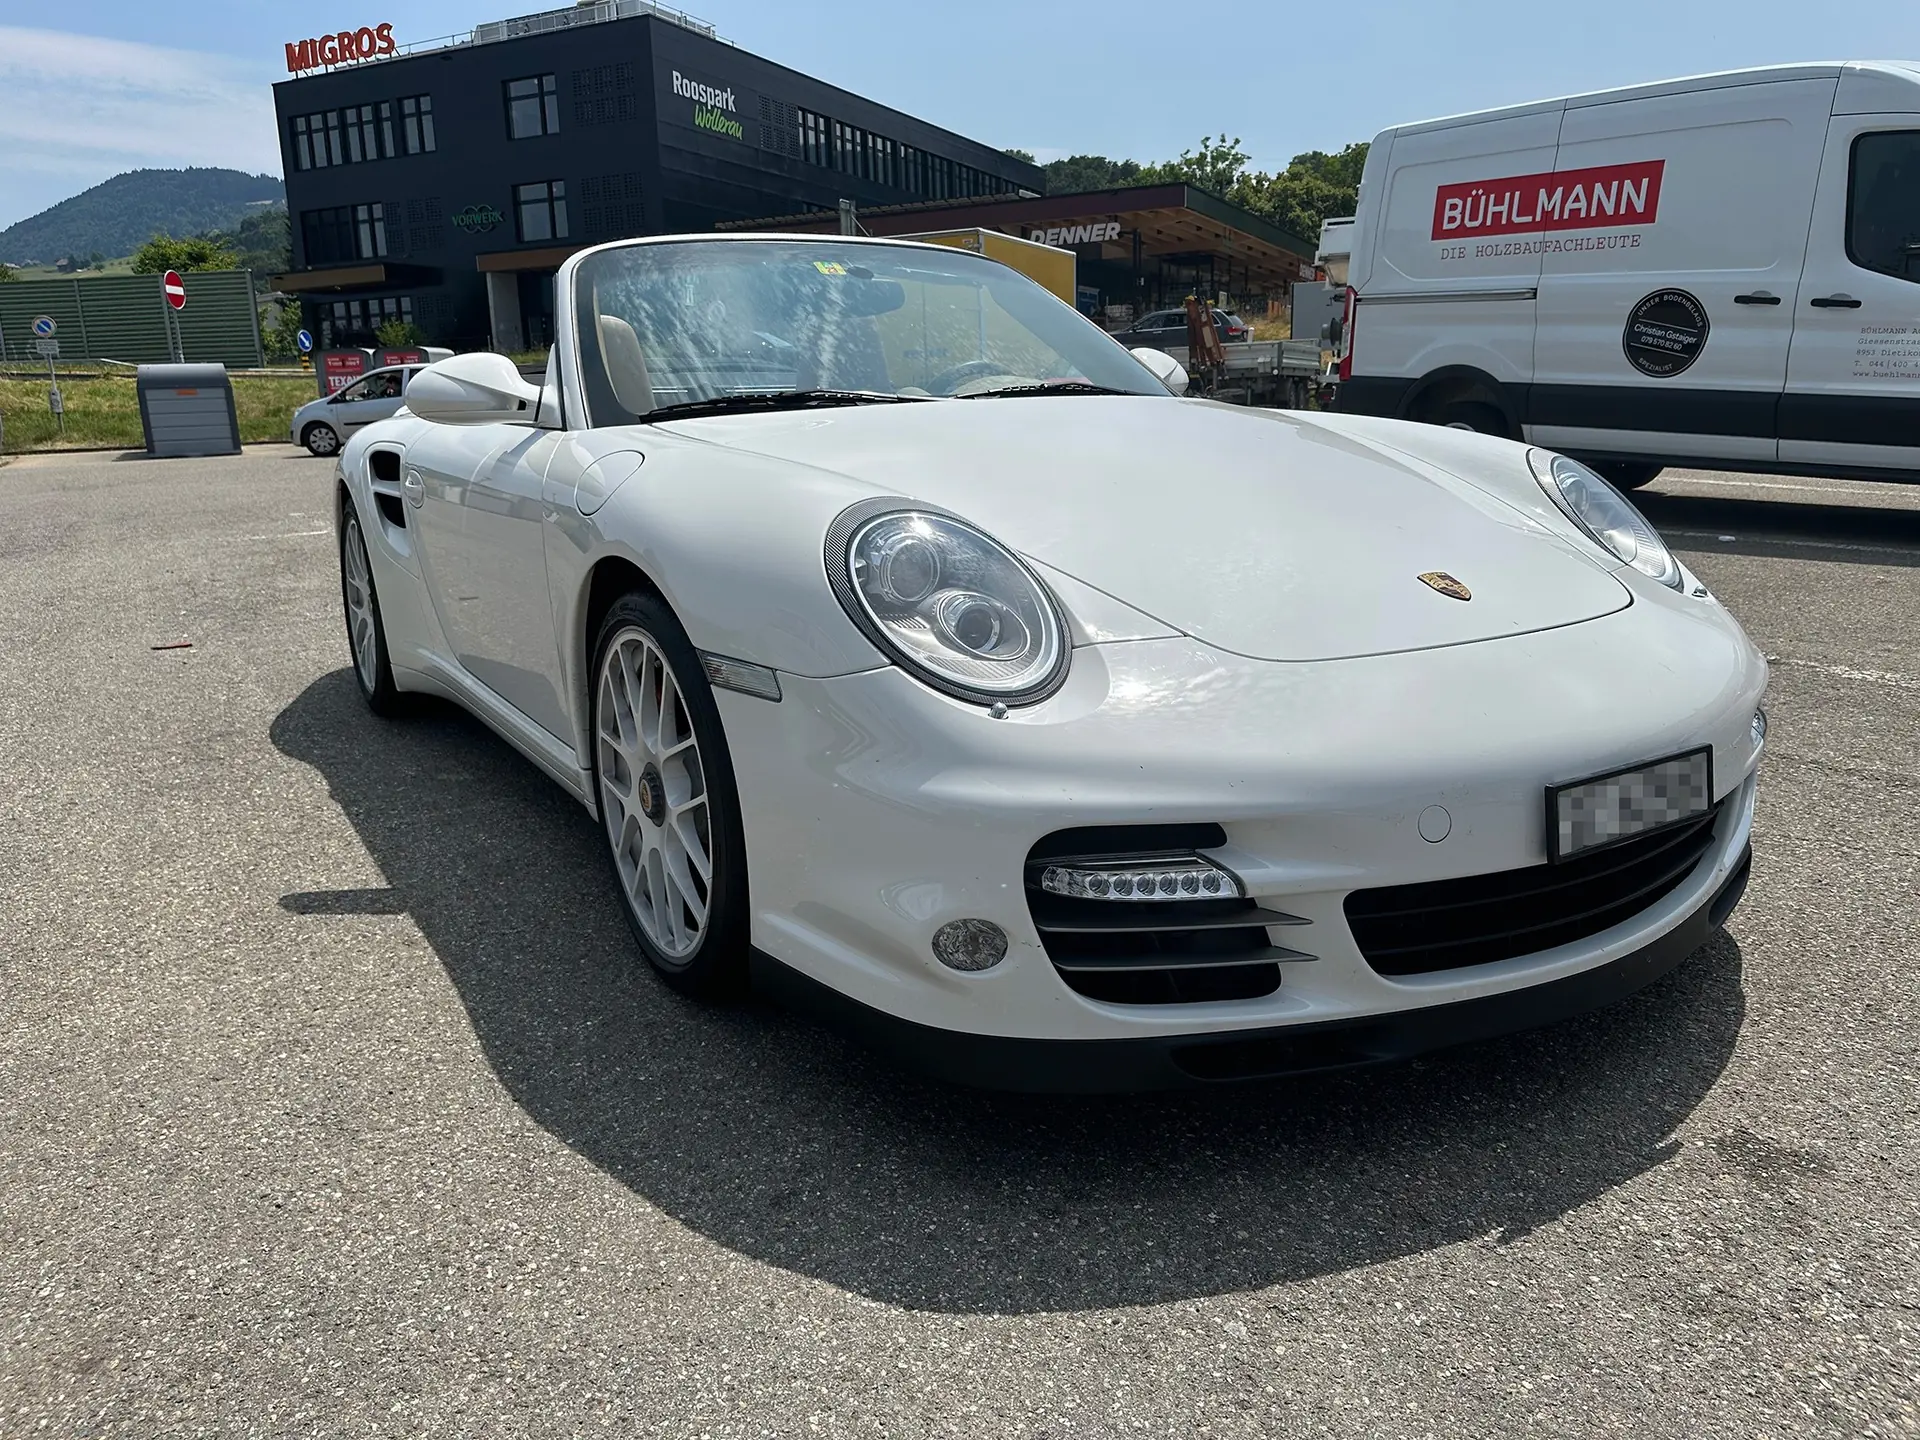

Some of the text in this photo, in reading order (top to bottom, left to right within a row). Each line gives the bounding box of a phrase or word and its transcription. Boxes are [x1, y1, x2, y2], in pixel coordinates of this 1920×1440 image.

[285, 22, 396, 73] MIGROS
[672, 70, 736, 112] Roospark
[694, 104, 743, 140] Wollerau
[1442, 177, 1649, 230] BÜHLMANN
[452, 211, 503, 227] VORWERK
[1030, 222, 1121, 246] DENNER
[1441, 234, 1641, 260] DIE HOLZBAUFACHLEUTE
[1637, 296, 1660, 316] UNSER
[1634, 323, 1698, 345] Christian Gstaiger
[1860, 326, 1907, 335] BÜHLMANN
[1640, 335, 1654, 344] 079
[1673, 342, 1682, 351] 60
[1881, 349, 1920, 357] Dietiko
[1639, 357, 1673, 372] SPEZIALIST
